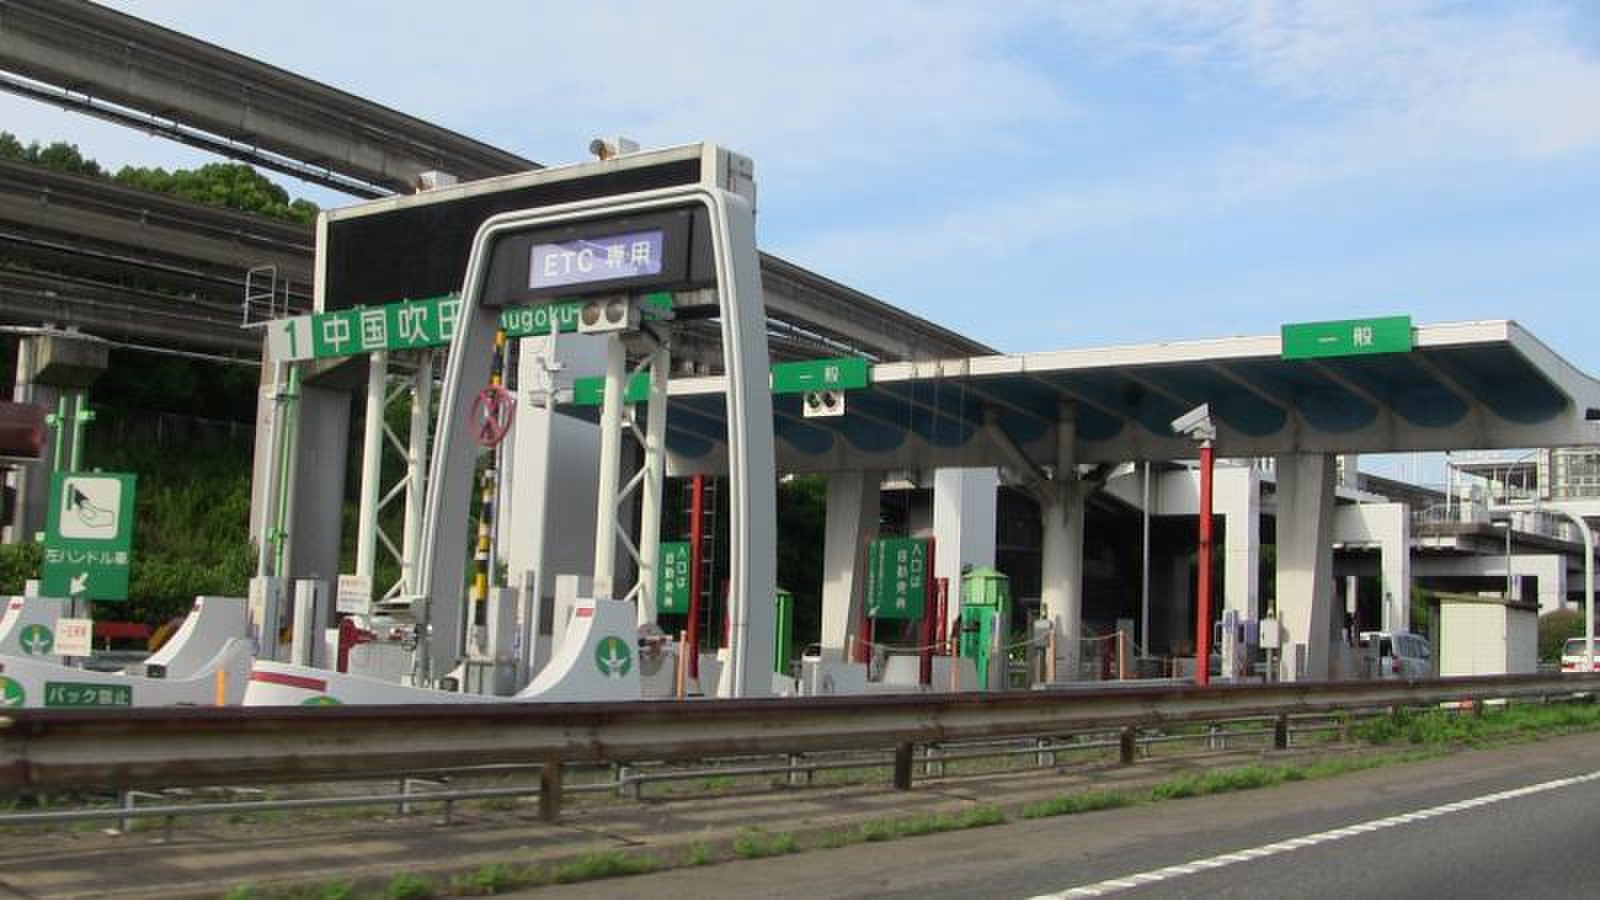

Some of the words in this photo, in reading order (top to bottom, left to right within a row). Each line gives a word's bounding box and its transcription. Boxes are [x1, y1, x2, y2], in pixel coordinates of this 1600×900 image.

[544, 248, 593, 277] ETC
[608, 241, 651, 271] 専用
[284, 320, 297, 359] 1
[322, 299, 464, 353] 中国吹田
[1317, 326, 1373, 348] 一般
[799, 365, 841, 383] 一般
